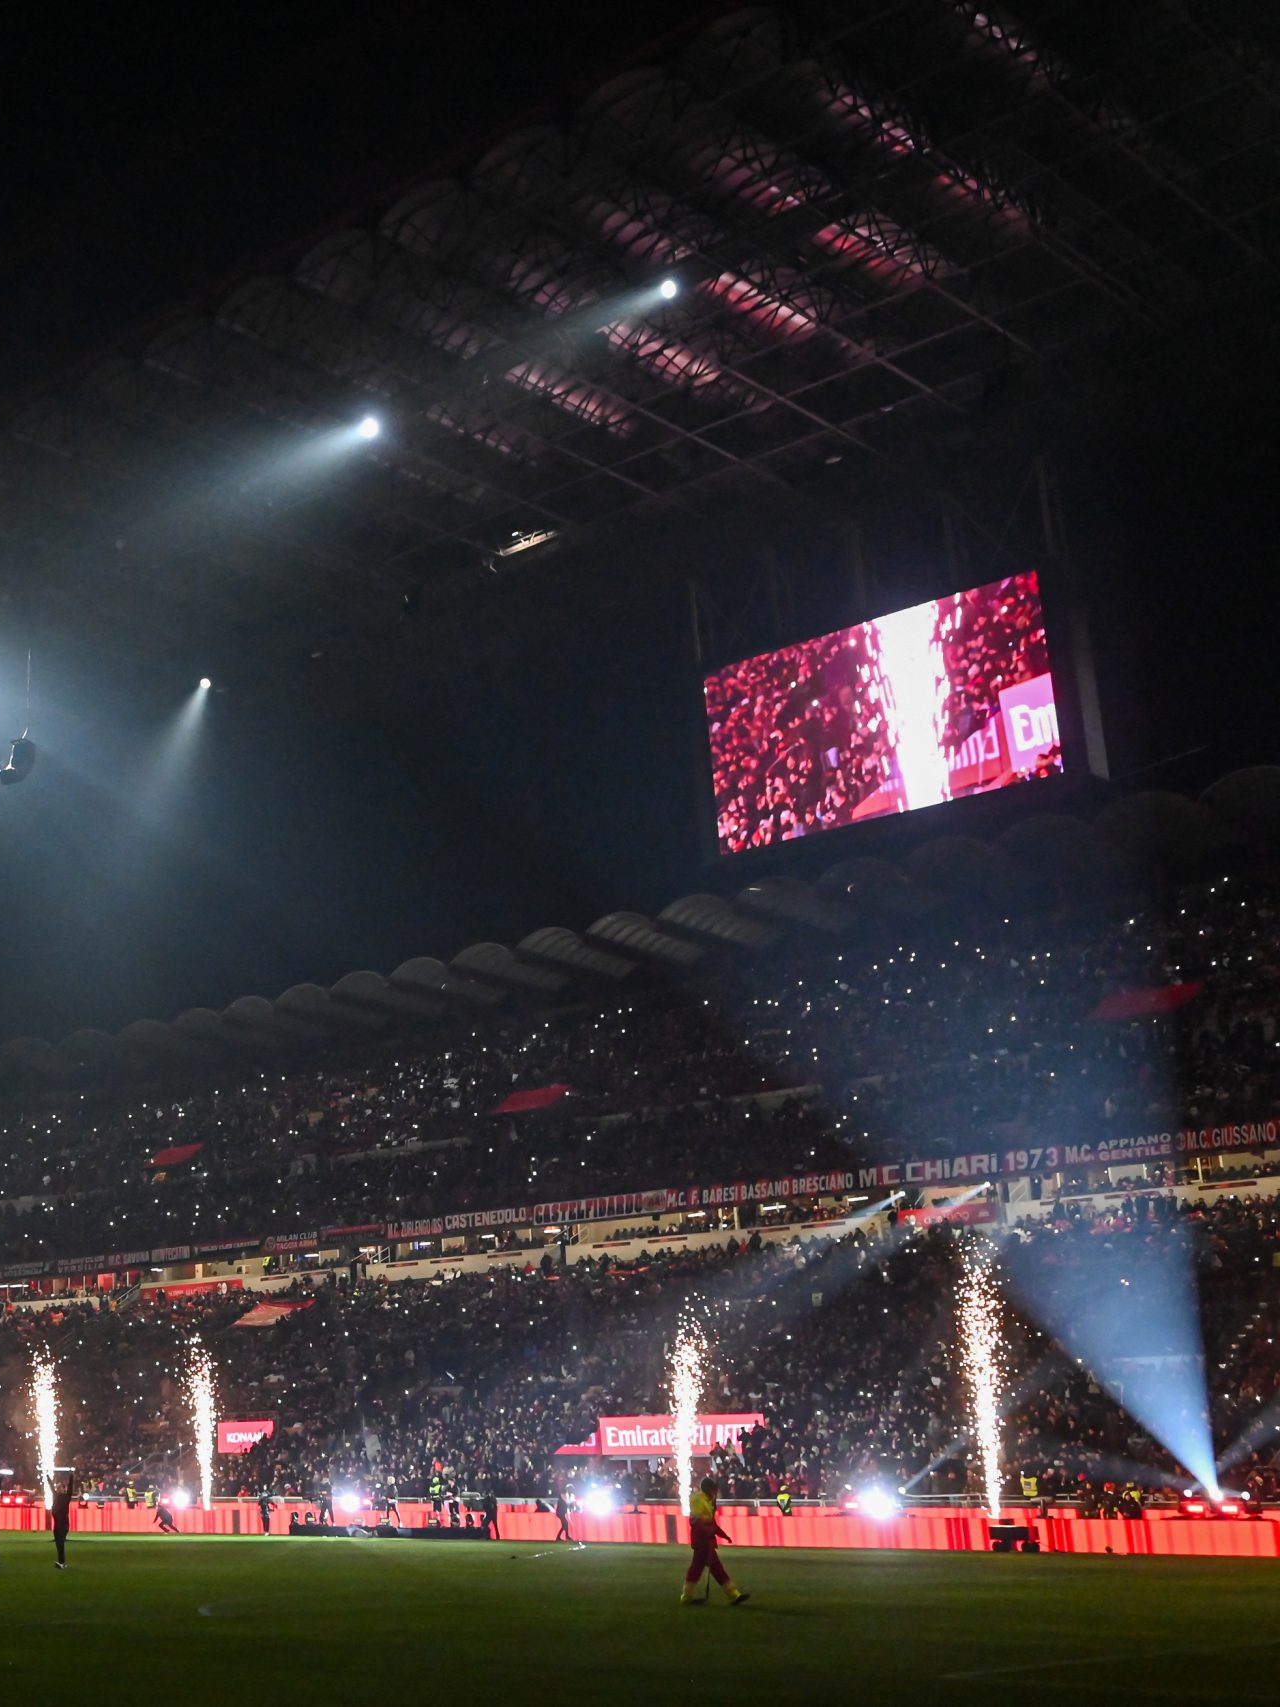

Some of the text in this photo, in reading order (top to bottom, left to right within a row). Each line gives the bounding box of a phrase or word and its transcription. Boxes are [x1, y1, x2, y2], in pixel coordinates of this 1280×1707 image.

[1064, 1132, 1171, 1164] M.C. APPIANO
[1184, 1121, 1277, 1151] M.C. GIUSSANO
[1005, 1147, 1058, 1172] 1973
[1098, 1144, 1171, 1161] GENTILE
[666, 1190, 687, 1207] M.C.
[702, 1186, 738, 1204] BARESI
[741, 1179, 790, 1200] BASSANO
[792, 1173, 853, 1194] BRESCIANO
[276, 1233, 299, 1242] MILAN
[300, 1231, 318, 1240] CLUB
[605, 1424, 678, 1448] Emirate
